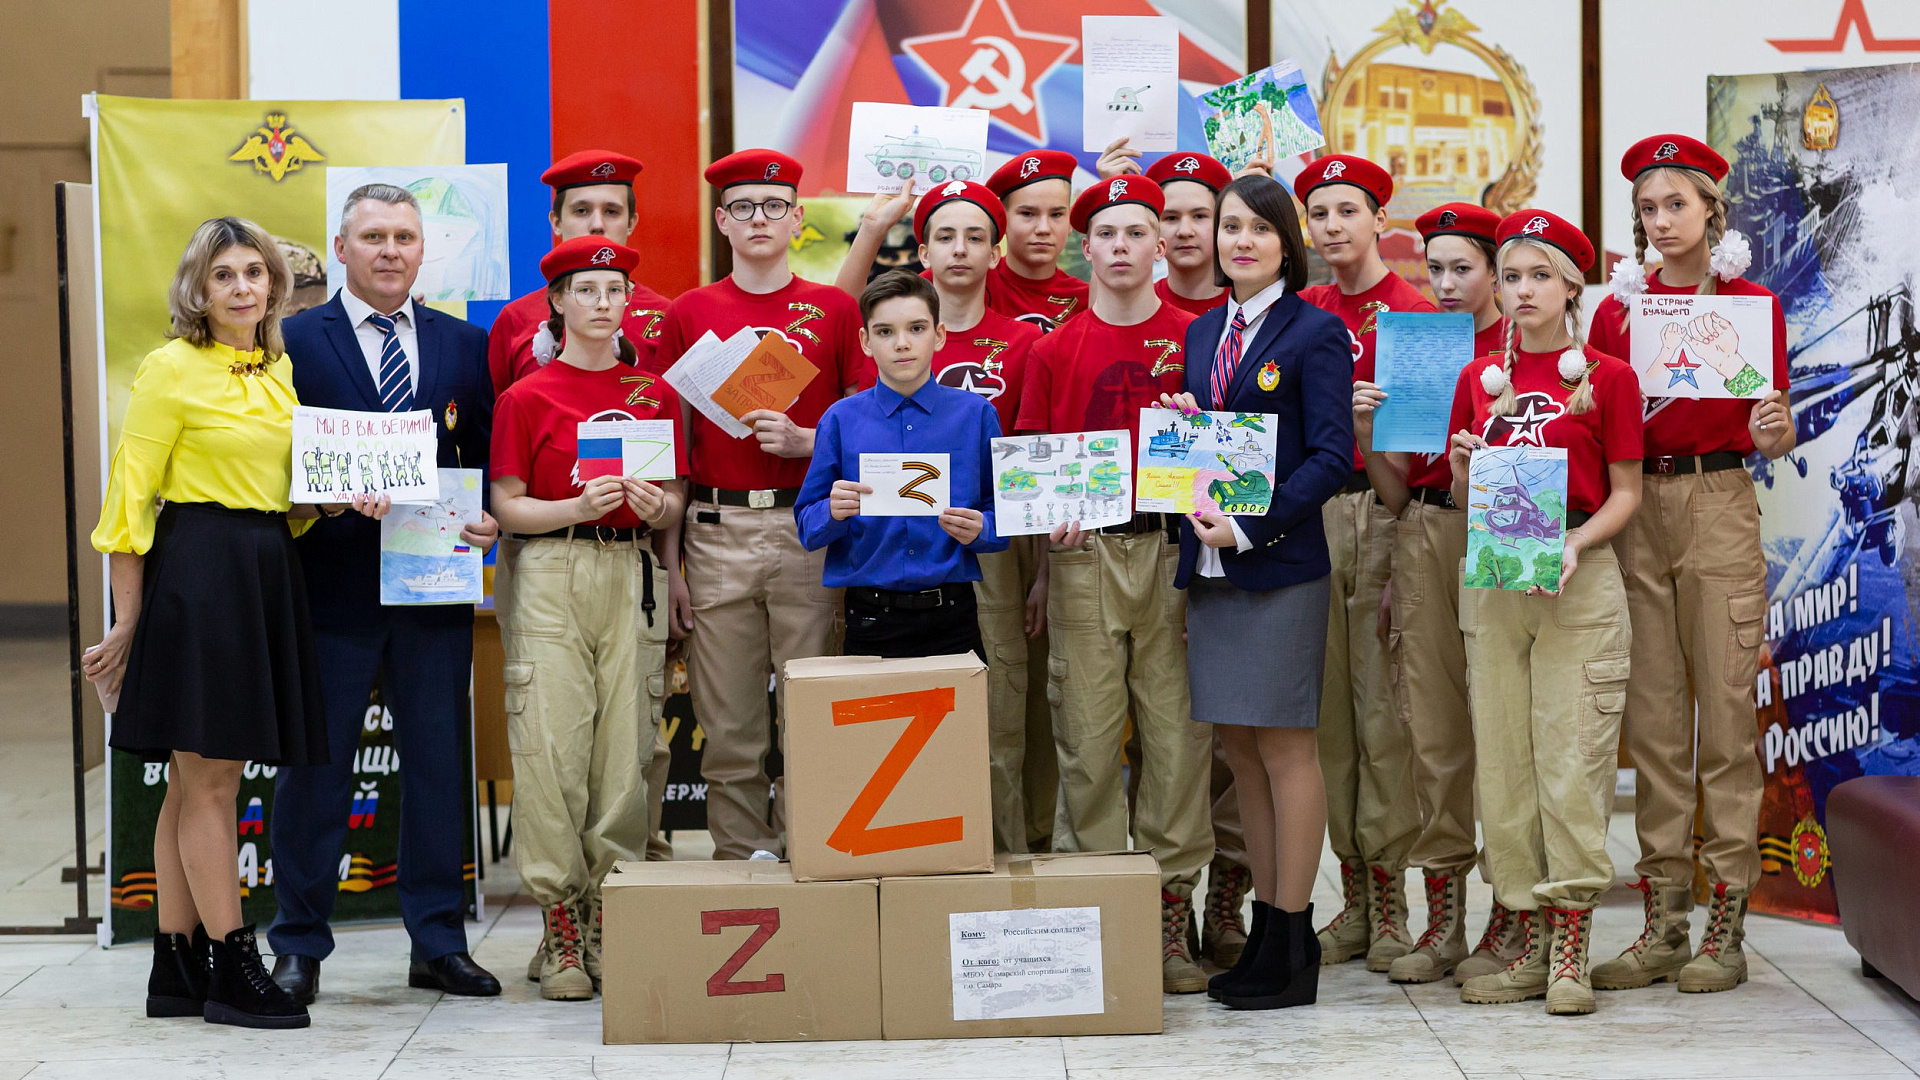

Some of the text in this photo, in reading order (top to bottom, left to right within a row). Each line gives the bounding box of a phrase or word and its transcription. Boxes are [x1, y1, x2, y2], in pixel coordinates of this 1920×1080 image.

[1641, 298, 1653, 306] НА
[316, 415, 432, 437] МЫ В ВАС ВЕРИМ!!!
[898, 461, 942, 508] Z
[1764, 563, 1857, 641] А МИР!
[1781, 616, 1891, 701] ПРАВДУ!
[826, 687, 963, 857] Z
[961, 926, 1086, 939] Кому: Российским солдатам
[700, 906, 786, 998] Z
[962, 958, 973, 966] От
[978, 958, 1000, 966] кого:
[1014, 956, 1052, 966] учащихся
[963, 971, 986, 979] МБОУ
[988, 969, 1026, 979] Самарский
[976, 981, 1003, 990] Самара
